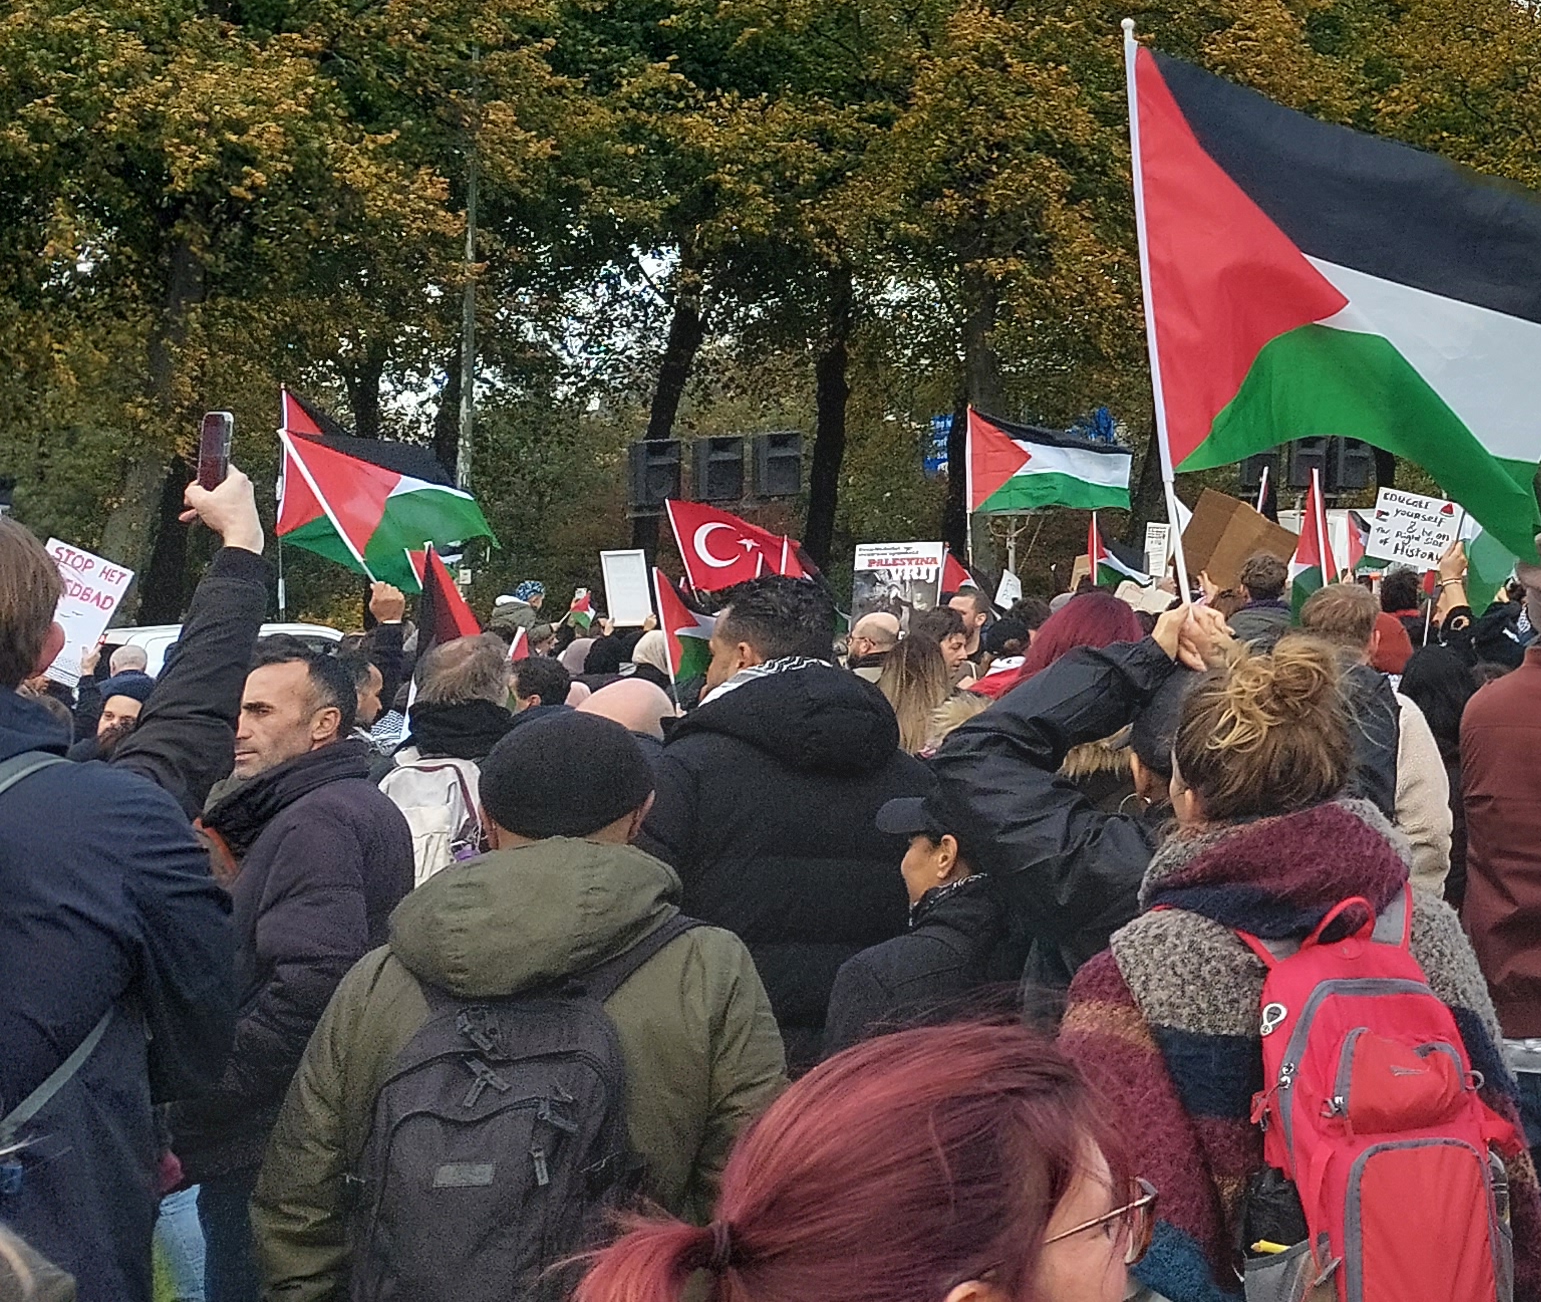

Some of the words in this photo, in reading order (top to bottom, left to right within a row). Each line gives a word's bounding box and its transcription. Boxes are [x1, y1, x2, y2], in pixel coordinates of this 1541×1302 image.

[55, 546, 95, 572] STOP
[98, 565, 127, 585] HET
[867, 556, 939, 568] PALESTINA
[66, 578, 115, 610] DBAD
